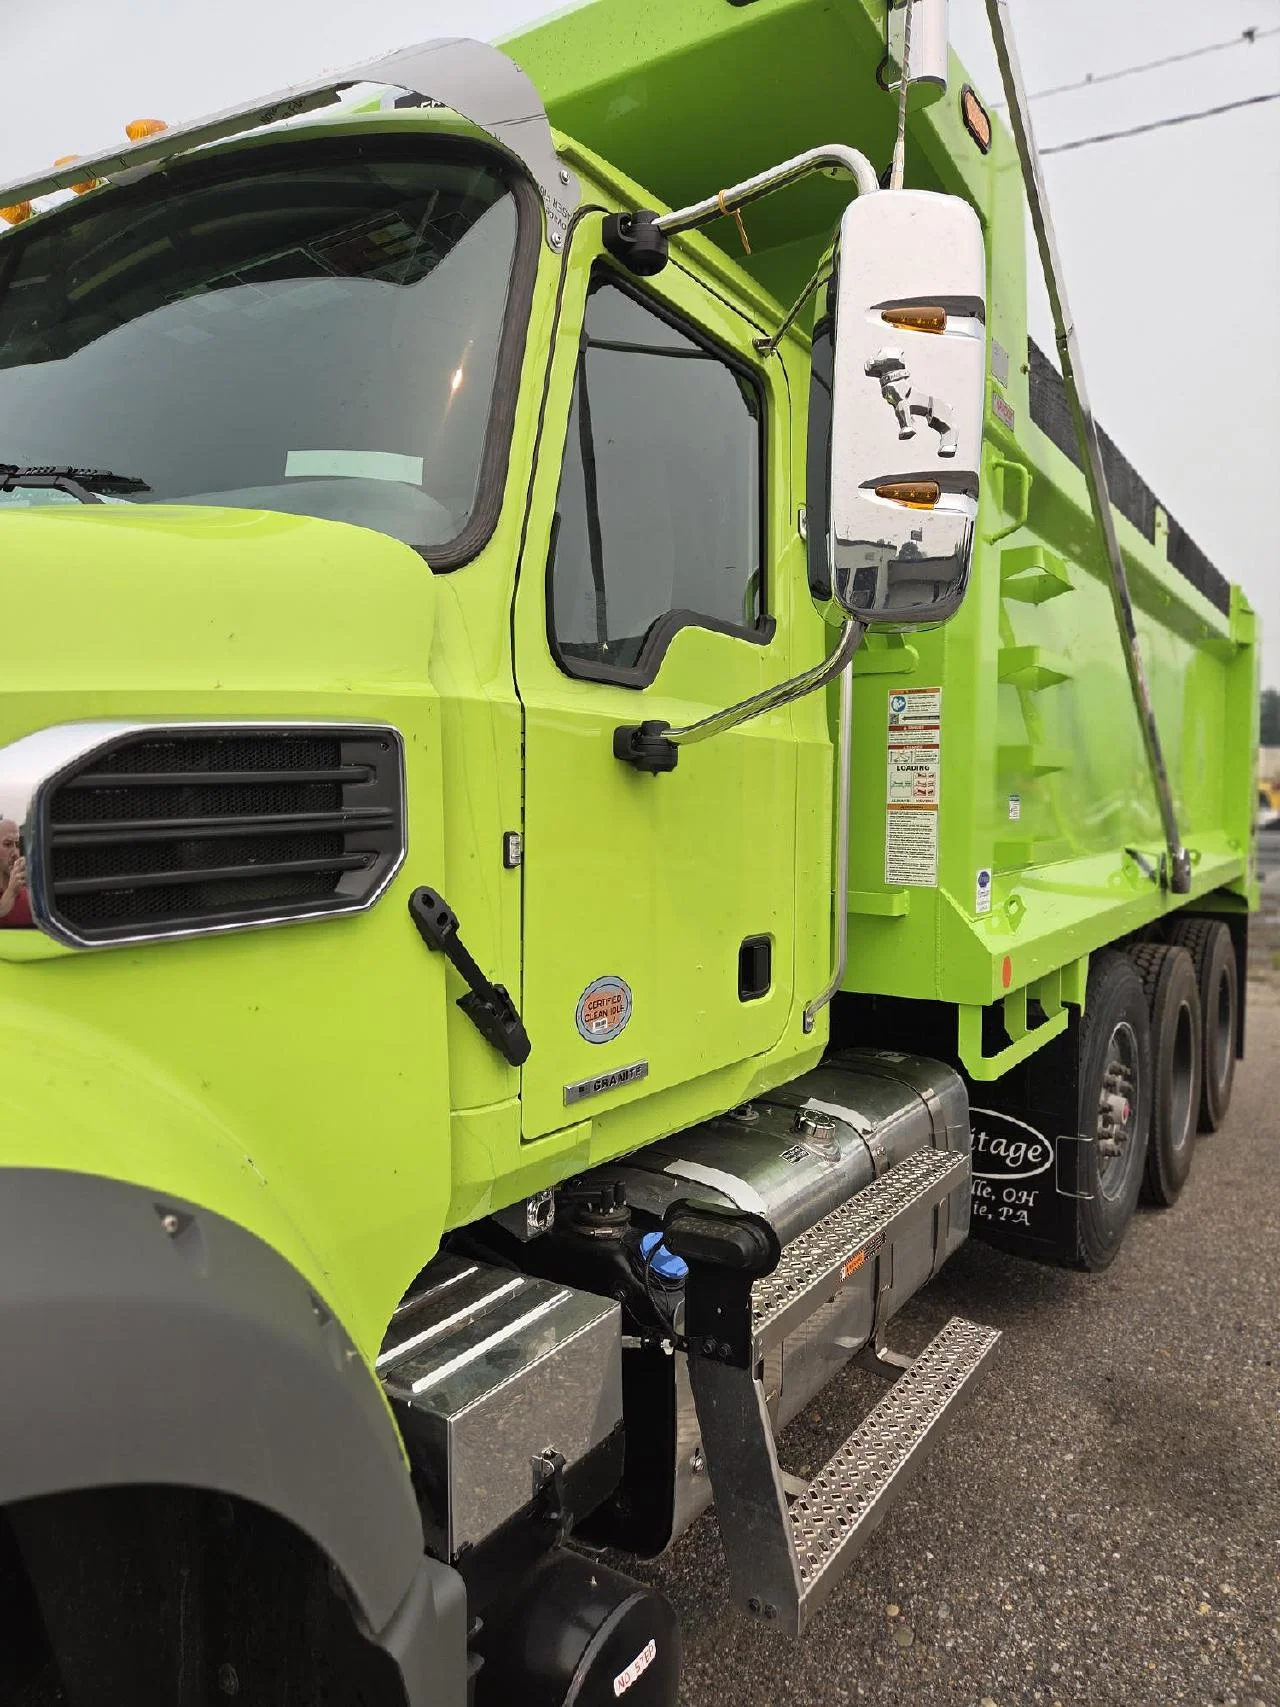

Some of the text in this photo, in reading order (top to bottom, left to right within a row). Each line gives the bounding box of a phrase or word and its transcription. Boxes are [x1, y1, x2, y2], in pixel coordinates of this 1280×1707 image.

[587, 994, 622, 1011] CERTIFIED
[584, 1003, 625, 1023] CLEAN IDLE
[593, 1066, 642, 1092] GRANITE
[1002, 1187, 1039, 1207] OH
[998, 1207, 1031, 1226] PA
[617, 1671, 631, 1690] NO
